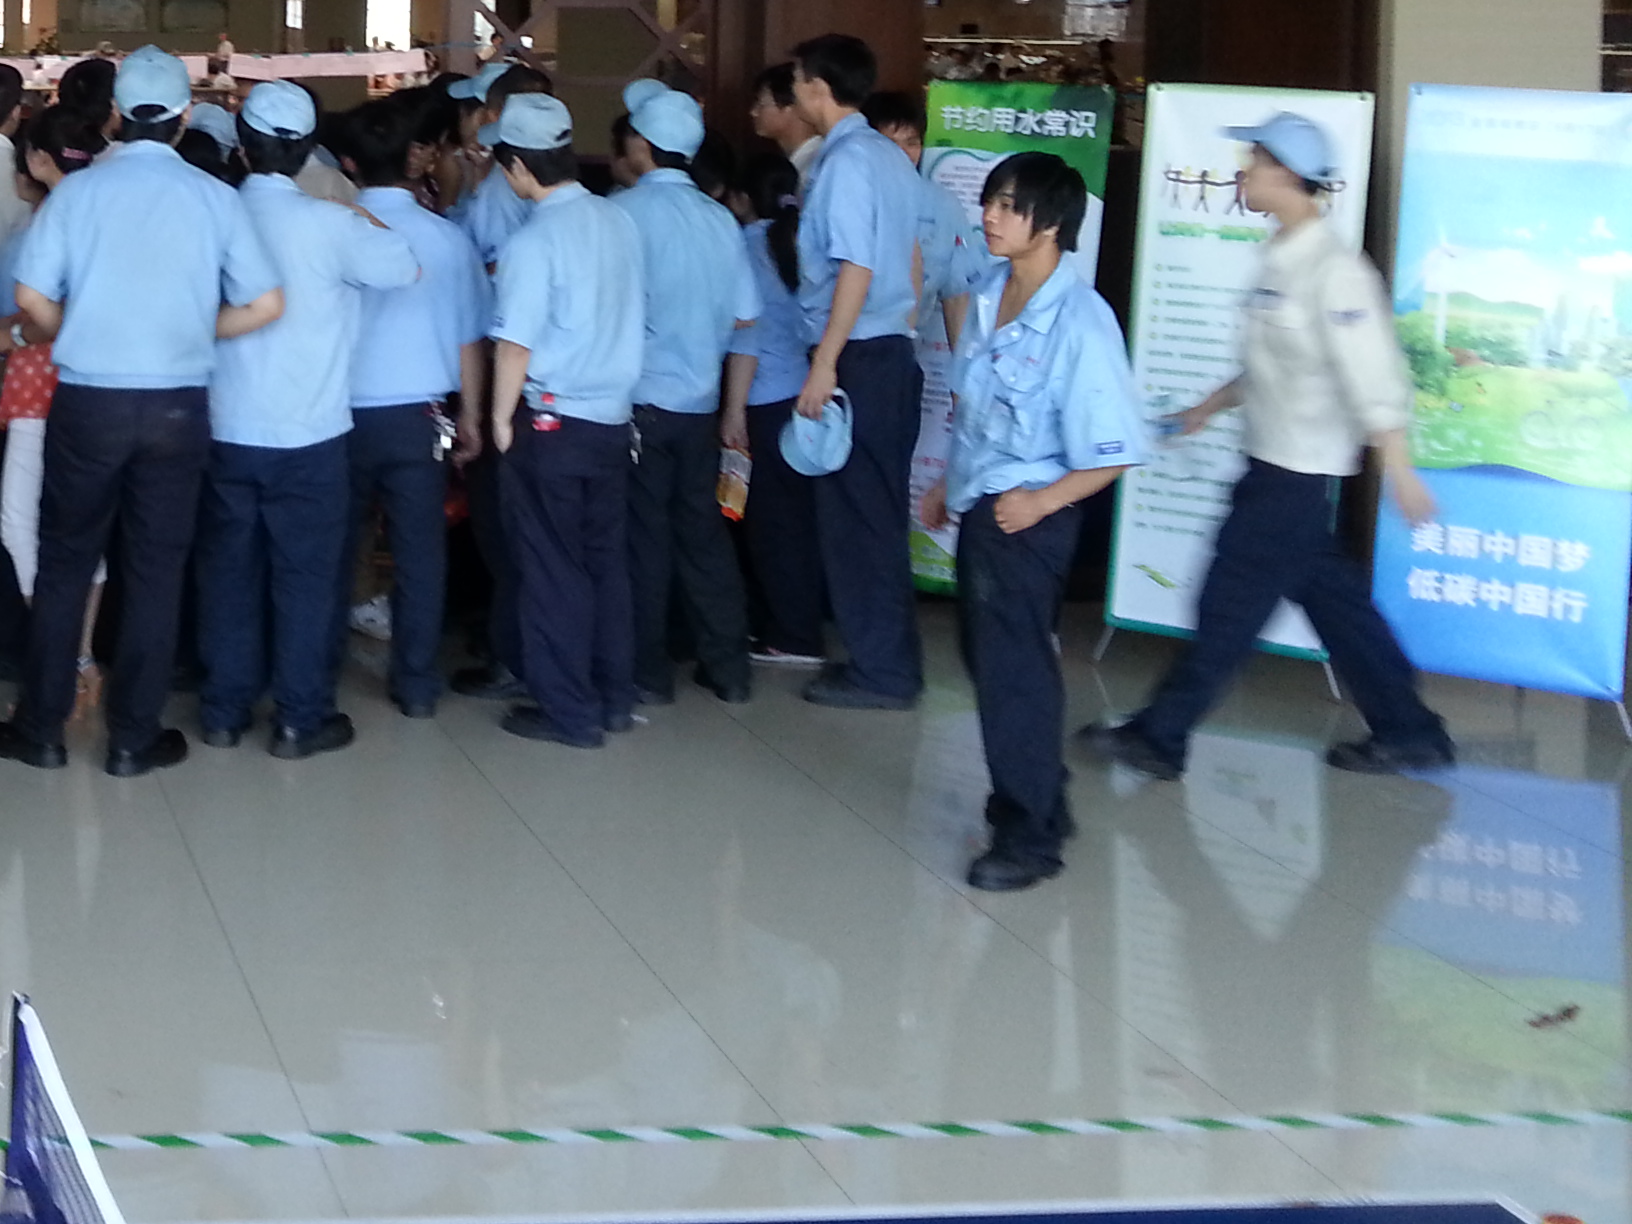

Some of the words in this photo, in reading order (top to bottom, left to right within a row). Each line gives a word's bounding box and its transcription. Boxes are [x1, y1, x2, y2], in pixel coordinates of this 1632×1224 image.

[940, 105, 1097, 139] 节约用水常识
[1410, 522, 1591, 572] 美丽中国梦
[1406, 565, 1588, 623] 低碳中国行
